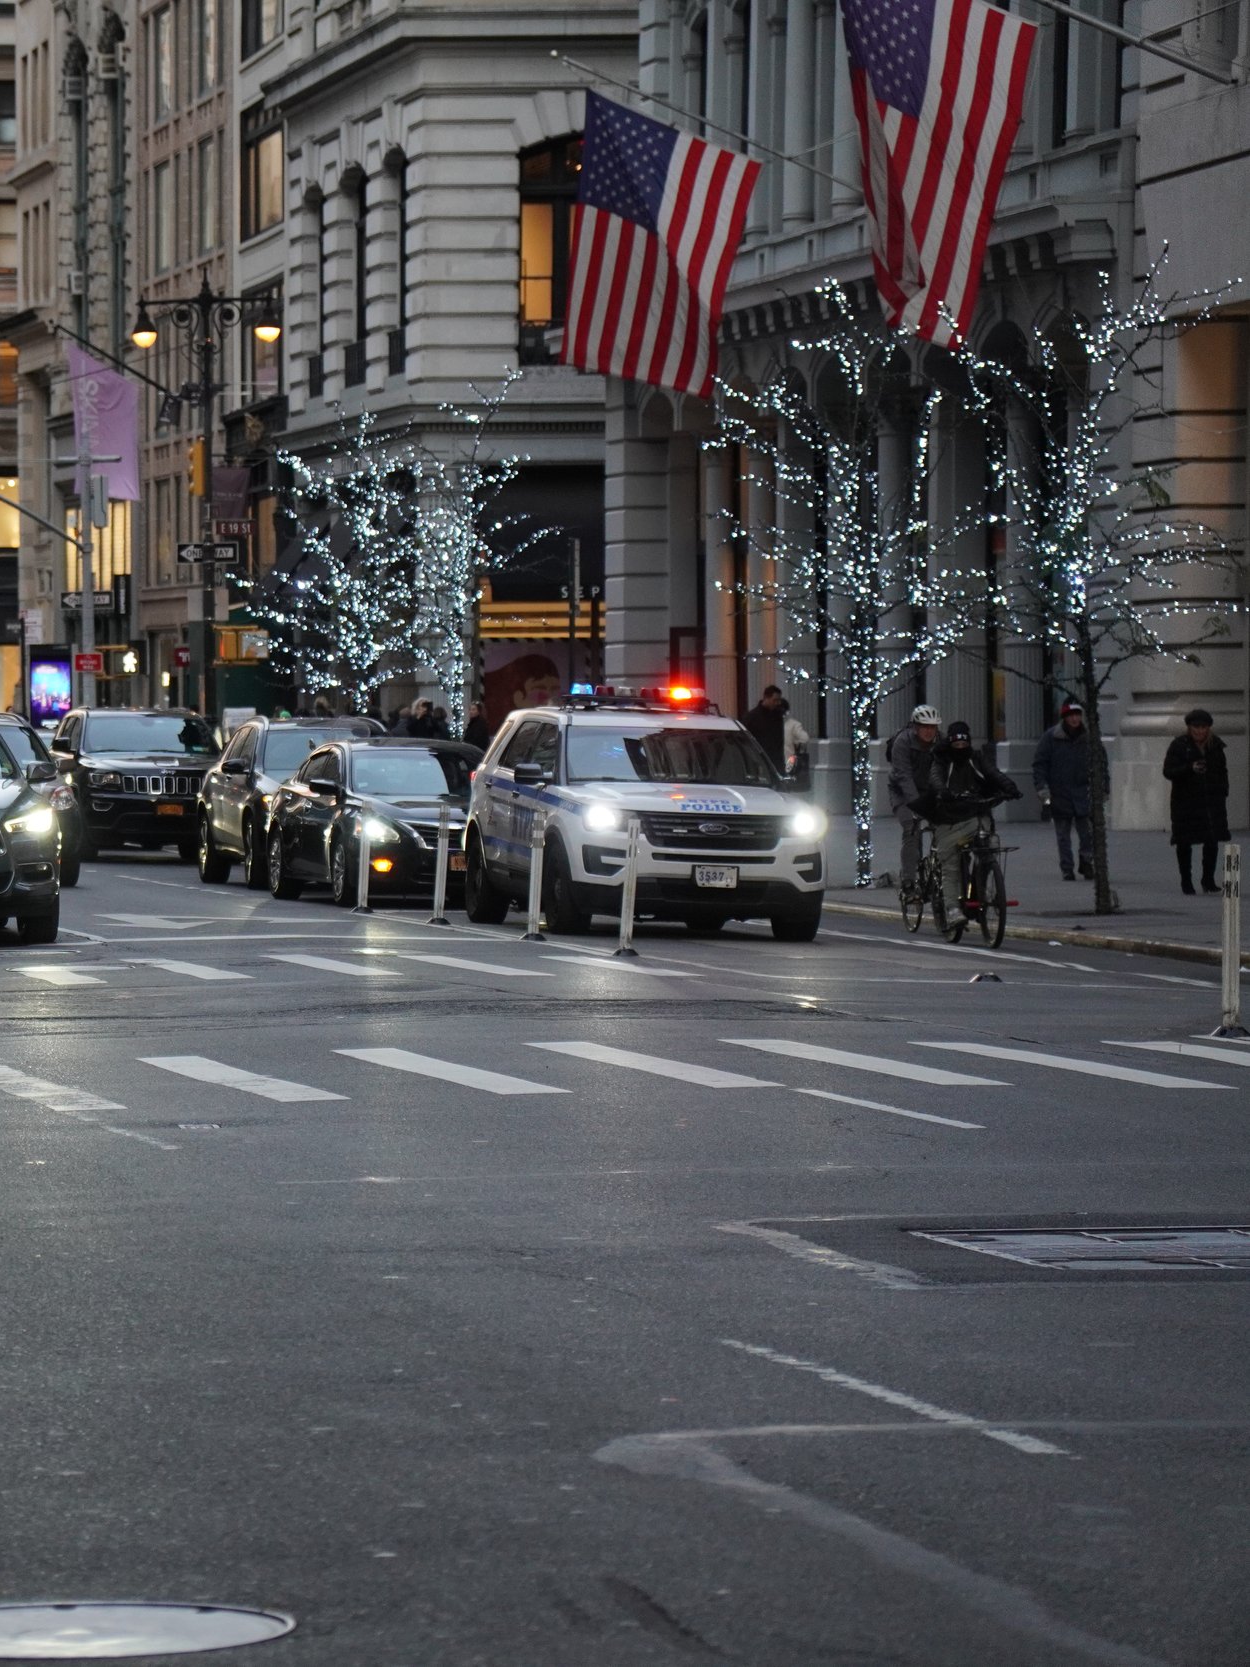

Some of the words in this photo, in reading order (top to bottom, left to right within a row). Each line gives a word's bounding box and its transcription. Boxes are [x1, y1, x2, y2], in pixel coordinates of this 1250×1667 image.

[221, 523, 227, 533] E
[229, 522, 239, 533] 19
[681, 803, 743, 813] POLICE
[698, 871, 725, 882] 3537
